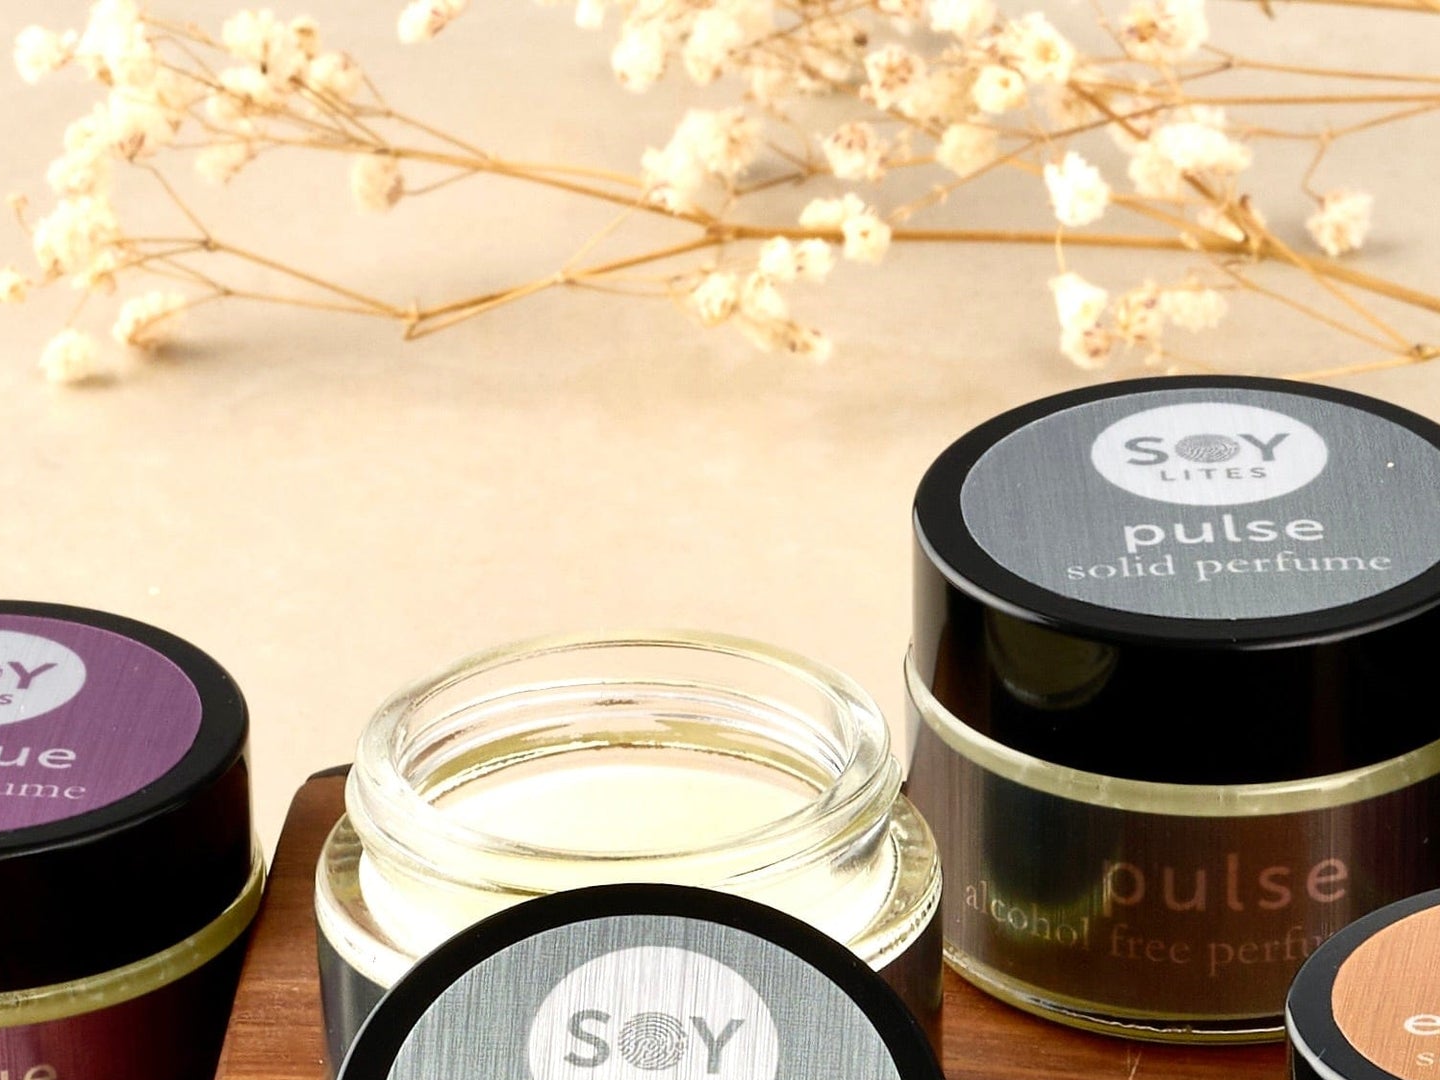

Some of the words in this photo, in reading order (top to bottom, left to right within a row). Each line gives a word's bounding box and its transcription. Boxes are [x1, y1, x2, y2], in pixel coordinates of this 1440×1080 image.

[1124, 432, 1290, 466] SOY
[1160, 466, 1267, 481] LITES
[1123, 514, 1324, 552] pulse
[1066, 555, 1176, 580] solid
[1196, 550, 1392, 581] perfume
[1103, 852, 1350, 917] pulse
[964, 880, 1091, 946] alcohol
[1108, 927, 1192, 965] free
[563, 1009, 746, 1074] SOY
